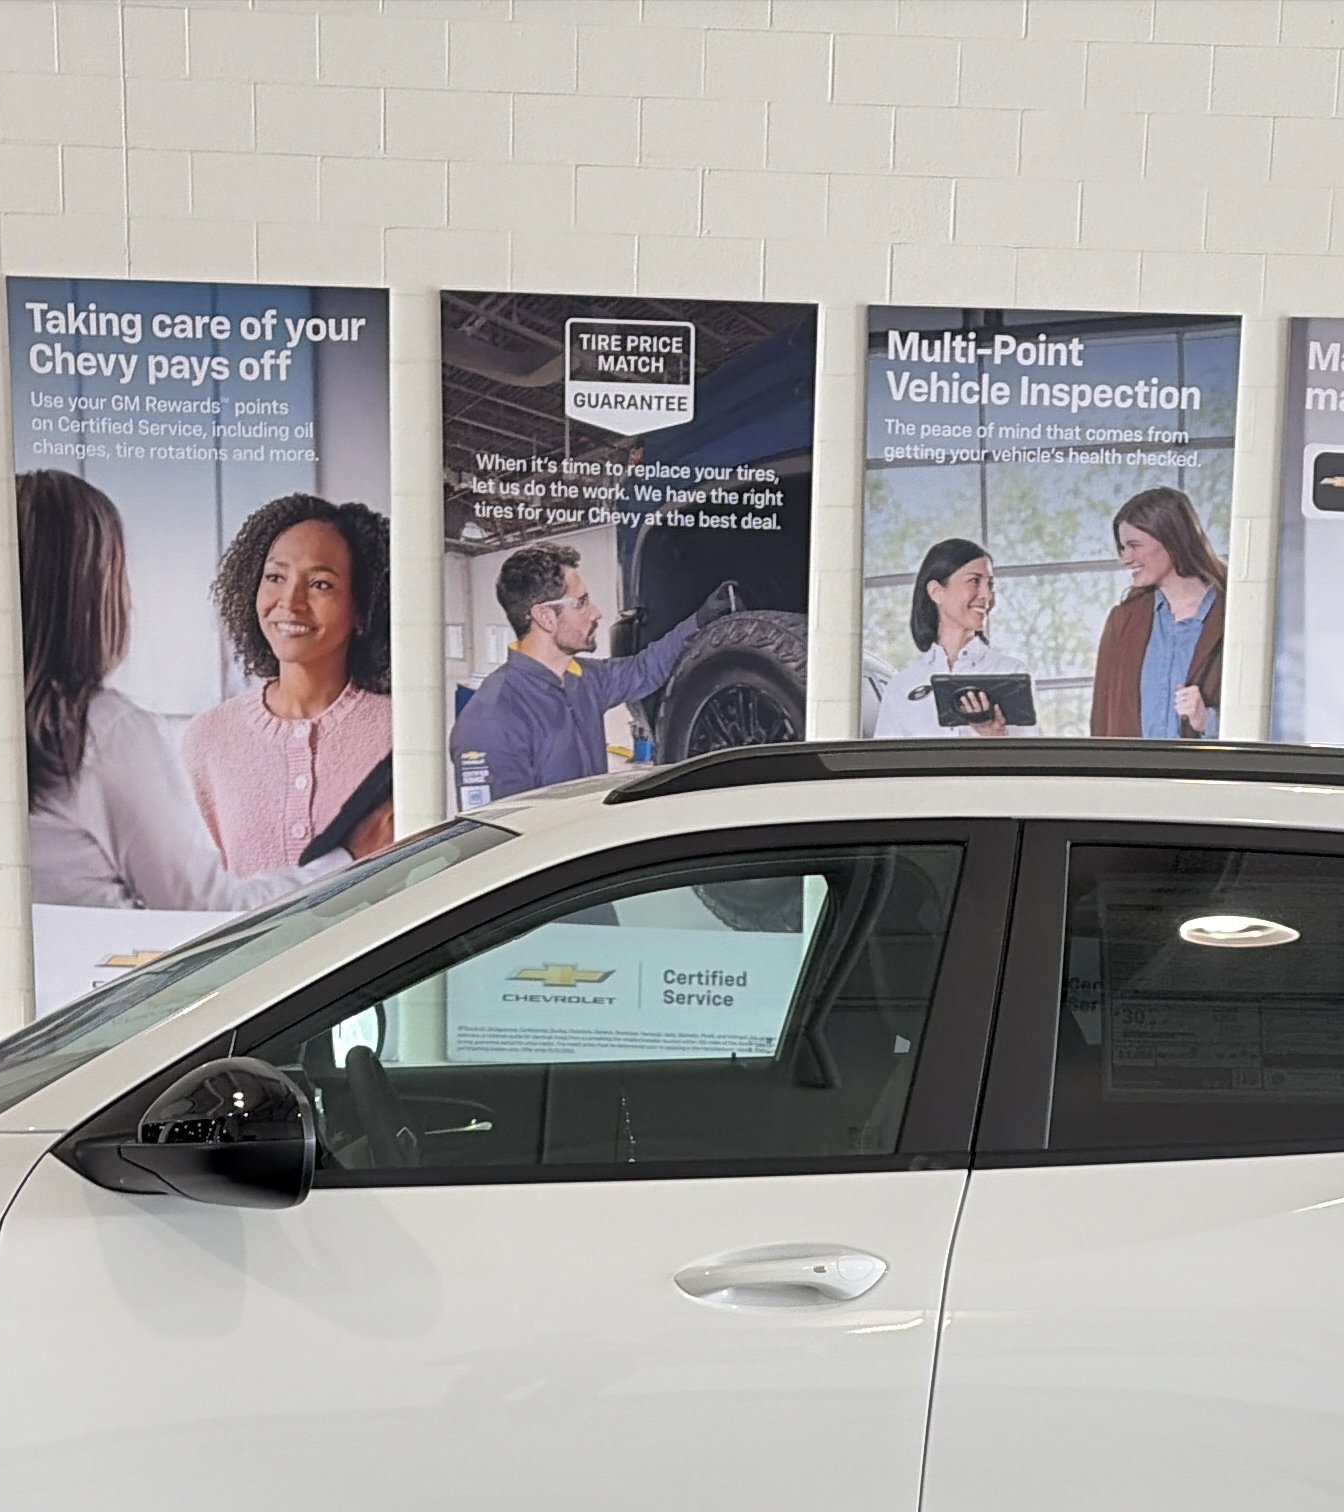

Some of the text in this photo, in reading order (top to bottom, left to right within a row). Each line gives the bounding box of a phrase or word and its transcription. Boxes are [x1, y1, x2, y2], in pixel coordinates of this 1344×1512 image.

[25, 302, 365, 347] Taking care of your
[579, 333, 683, 354] TIRE PRICE
[887, 329, 1084, 366] Multi-Point
[29, 343, 292, 386] Chevy pays off
[598, 355, 664, 373] MATCH
[574, 392, 688, 412] GUARANTEE
[886, 370, 1201, 413] Vehicle Inspection
[30, 392, 288, 416] Use your GM points
[32, 416, 314, 441] on Certified Service, including oil
[884, 419, 1189, 443] The peace of mind that comes from
[33, 439, 319, 462] changes, tire rotations and more.
[884, 444, 1202, 468] getting your vehicle's health checked.
[476, 454, 780, 484] When it's time to replace your tires,
[472, 478, 784, 509] let us do the work. We have the right
[474, 501, 781, 530] tires for your Chevy at the best deal.
[663, 969, 747, 988] Certified
[503, 993, 616, 1005] CHEVROLET
[663, 989, 734, 1008] Service
